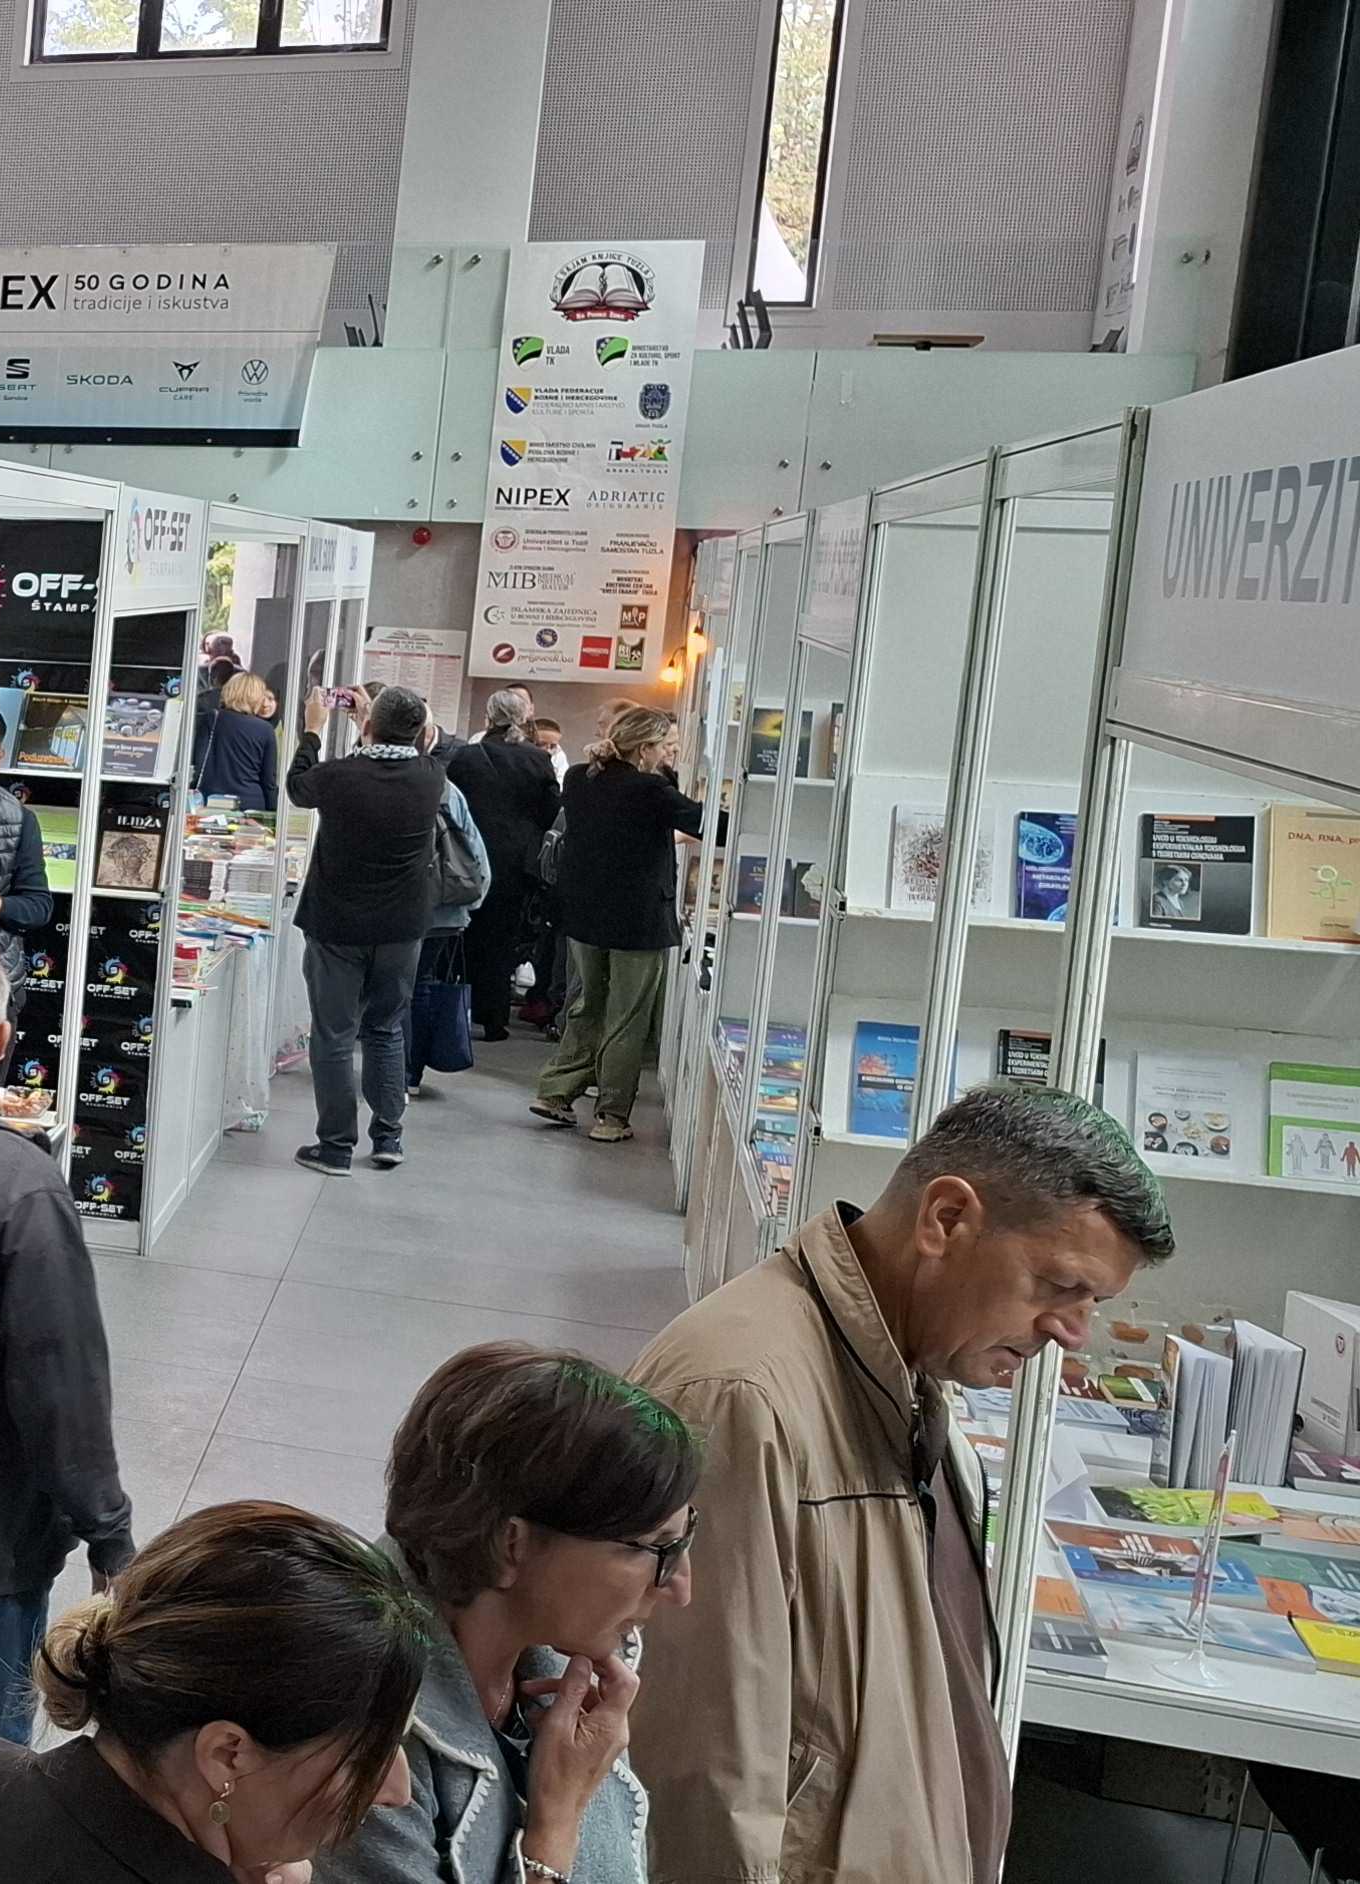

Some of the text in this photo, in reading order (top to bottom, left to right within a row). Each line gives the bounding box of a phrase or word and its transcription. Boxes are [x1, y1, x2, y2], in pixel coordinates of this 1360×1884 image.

[73, 273, 230, 291] 50 GODINA
[73, 295, 229, 314] tradicije i iskustva
[546, 345, 570, 355] VLADA
[495, 487, 571, 506] NIPEX
[588, 489, 666, 502] ADRIATIC
[144, 507, 191, 553] OFF-SET
[487, 571, 537, 590] MIB
[1287, 832, 1345, 844] DNA, RNA,
[87, 984, 138, 997] OFF-SET
[80, 1094, 130, 1106] OFF-SET
